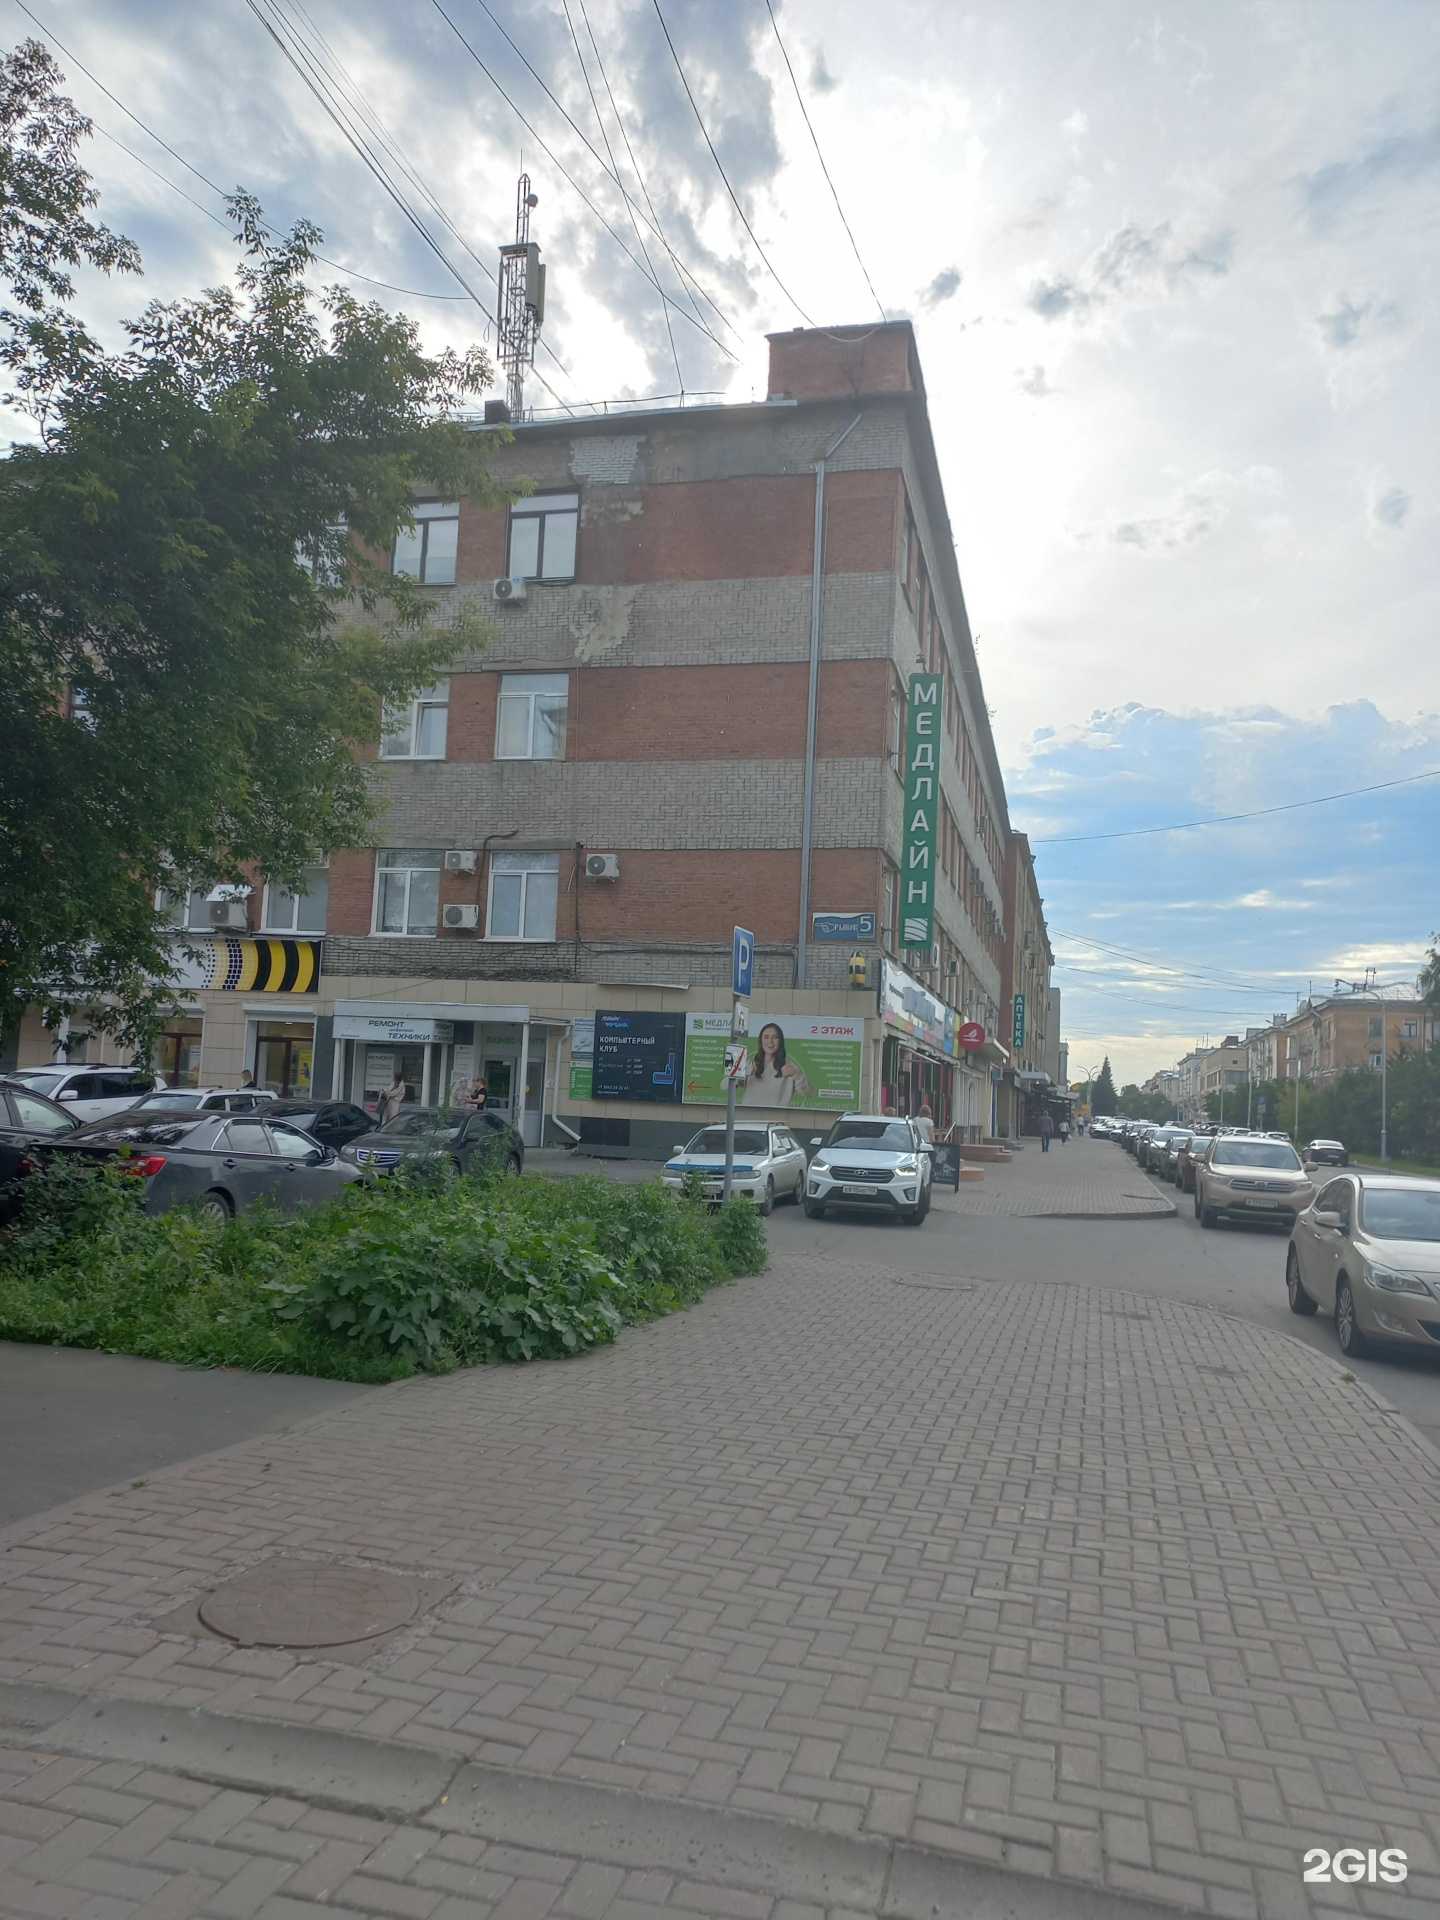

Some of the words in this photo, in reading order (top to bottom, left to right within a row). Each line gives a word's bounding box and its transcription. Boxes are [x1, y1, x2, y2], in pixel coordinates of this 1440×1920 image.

[908, 682, 937, 904] МЕДЛАЙН
[859, 916, 872, 932] 5
[738, 935, 750, 987] P
[367, 1019, 405, 1029] РЕМОНТ
[704, 1019, 734, 1027] МЕДЛ
[1015, 996, 1024, 1046] АПТЕКА
[810, 1025, 818, 1034] 2
[820, 1026, 854, 1036] ЭТАЖ
[386, 1032, 431, 1041] ТЕХНИКИ
[599, 1036, 655, 1046] КОМПЬЮТЕРНЫЙ
[599, 1045, 618, 1053] КЛУБ
